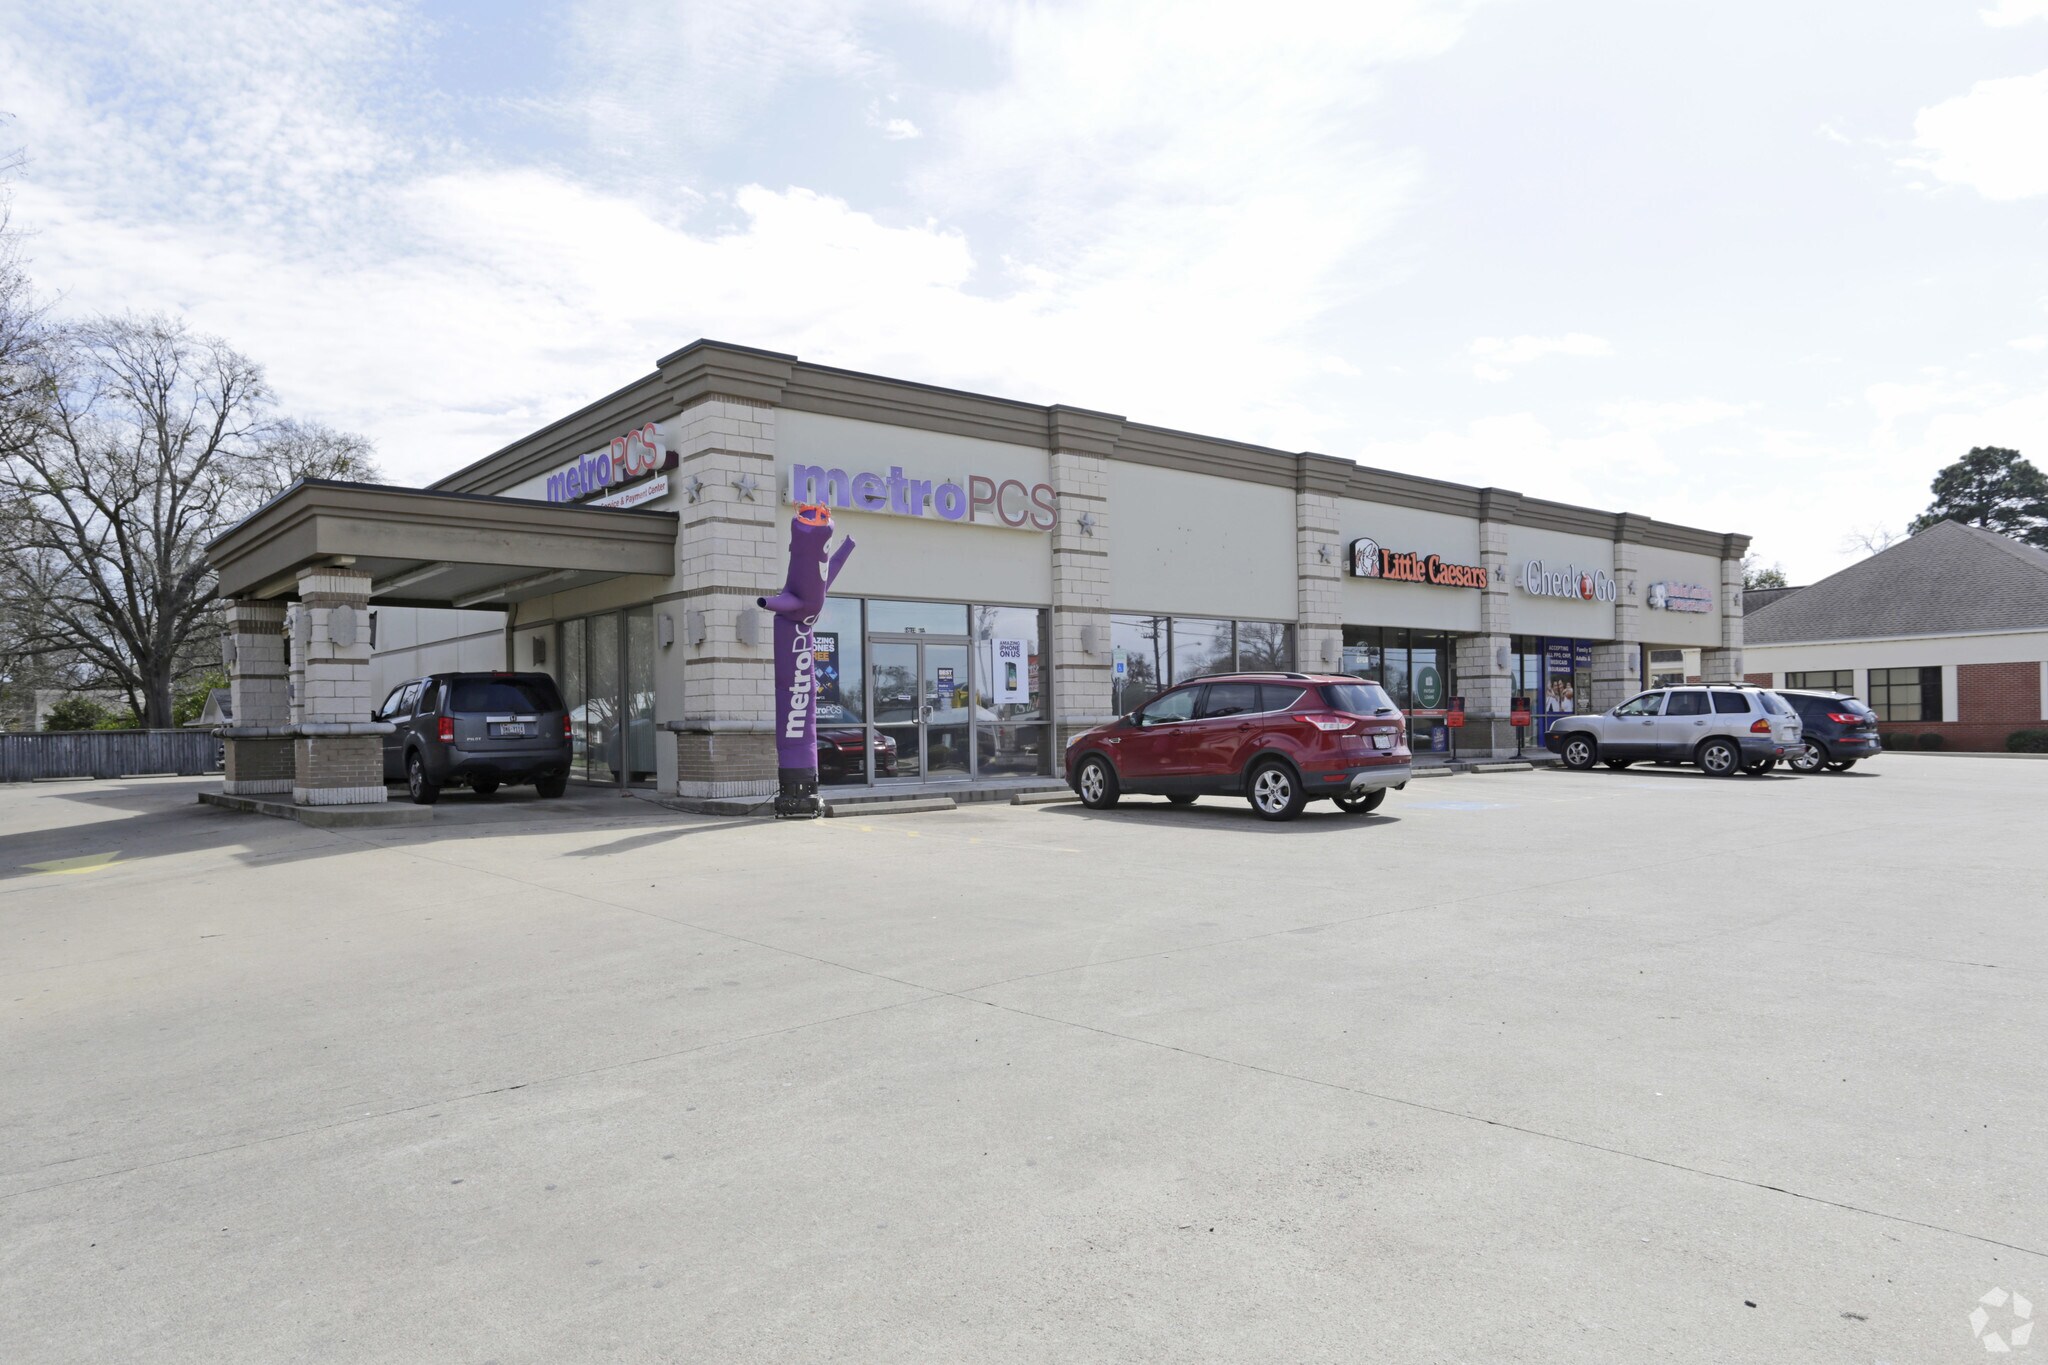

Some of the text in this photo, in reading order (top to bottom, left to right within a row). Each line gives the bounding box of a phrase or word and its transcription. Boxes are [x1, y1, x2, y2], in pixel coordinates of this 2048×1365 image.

[546, 421, 660, 503] metroPCS
[625, 489, 648, 505] Payment
[648, 482, 666, 496] Center
[793, 463, 1058, 531] metroPCS
[1382, 549, 1488, 588] Little Caesars
[1527, 560, 1580, 599] Check
[1594, 569, 1616, 602] Go
